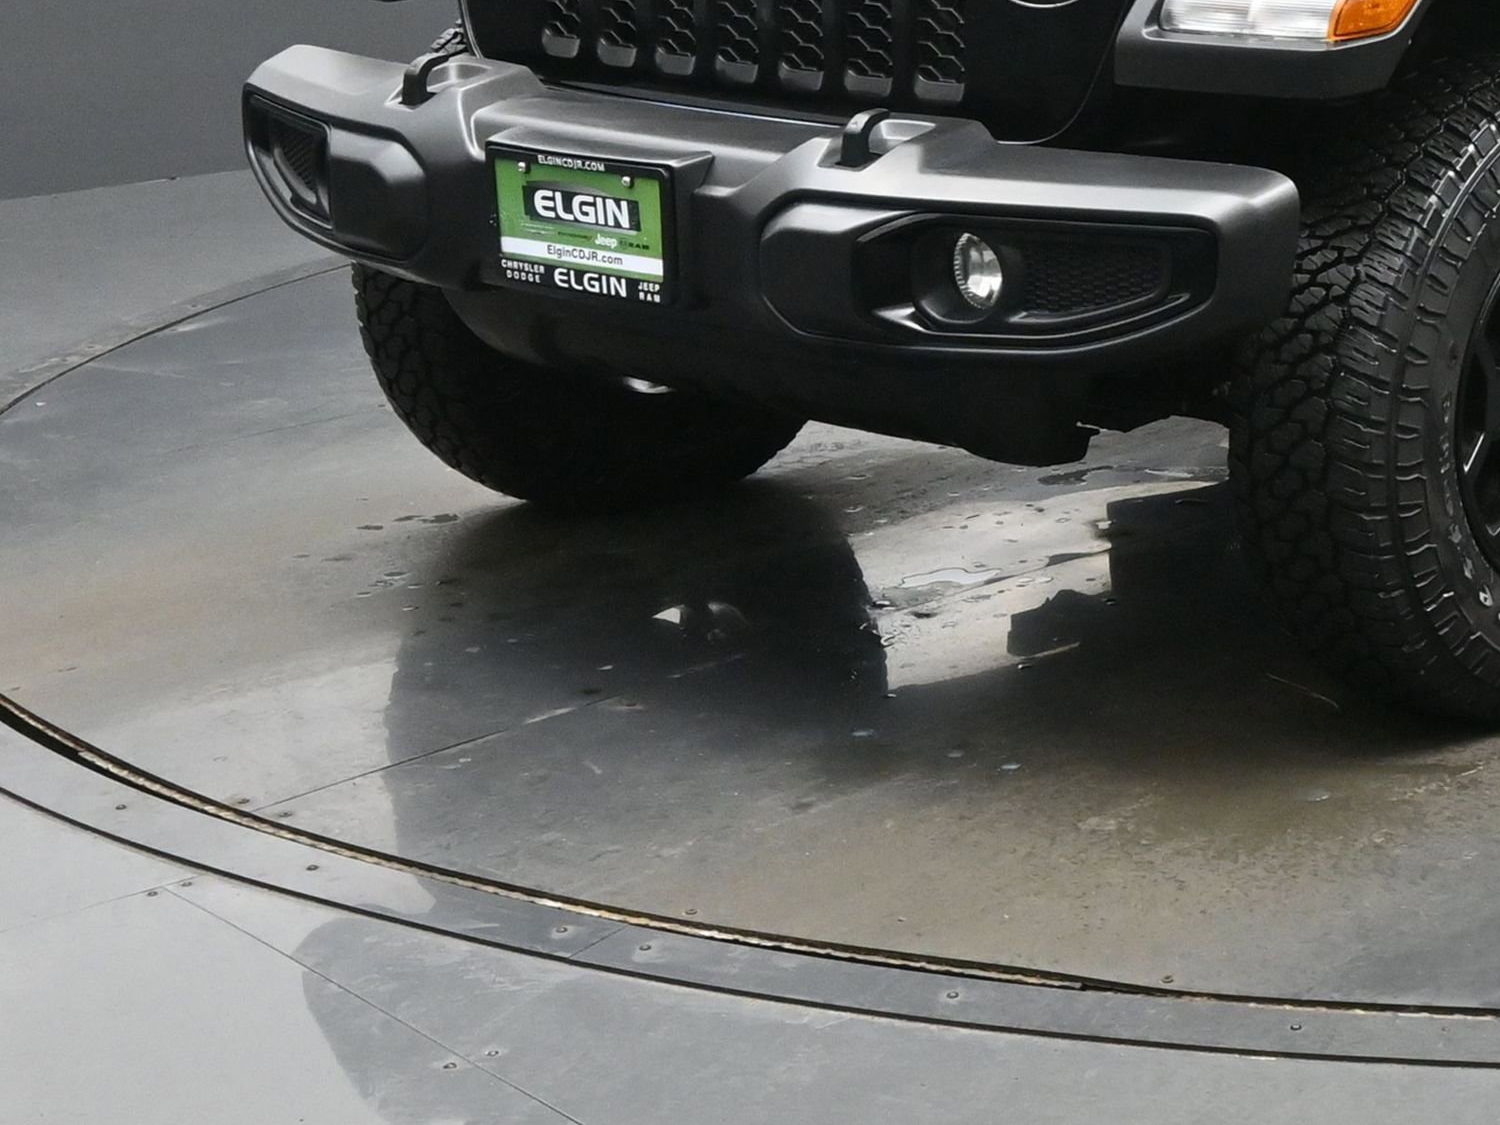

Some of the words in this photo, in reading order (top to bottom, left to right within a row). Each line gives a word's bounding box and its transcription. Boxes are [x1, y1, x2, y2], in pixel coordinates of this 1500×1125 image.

[537, 154, 606, 172] ELGINCDJR.COM
[533, 189, 631, 229] ELGIN
[594, 234, 618, 250] Jeep
[546, 244, 624, 266] ElginCDJR.com
[501, 258, 546, 275] CHRYSLER
[506, 269, 542, 284] DODGE
[553, 267, 628, 298] ELGIN
[637, 281, 661, 293] JEEP
[638, 291, 661, 303] RAM
